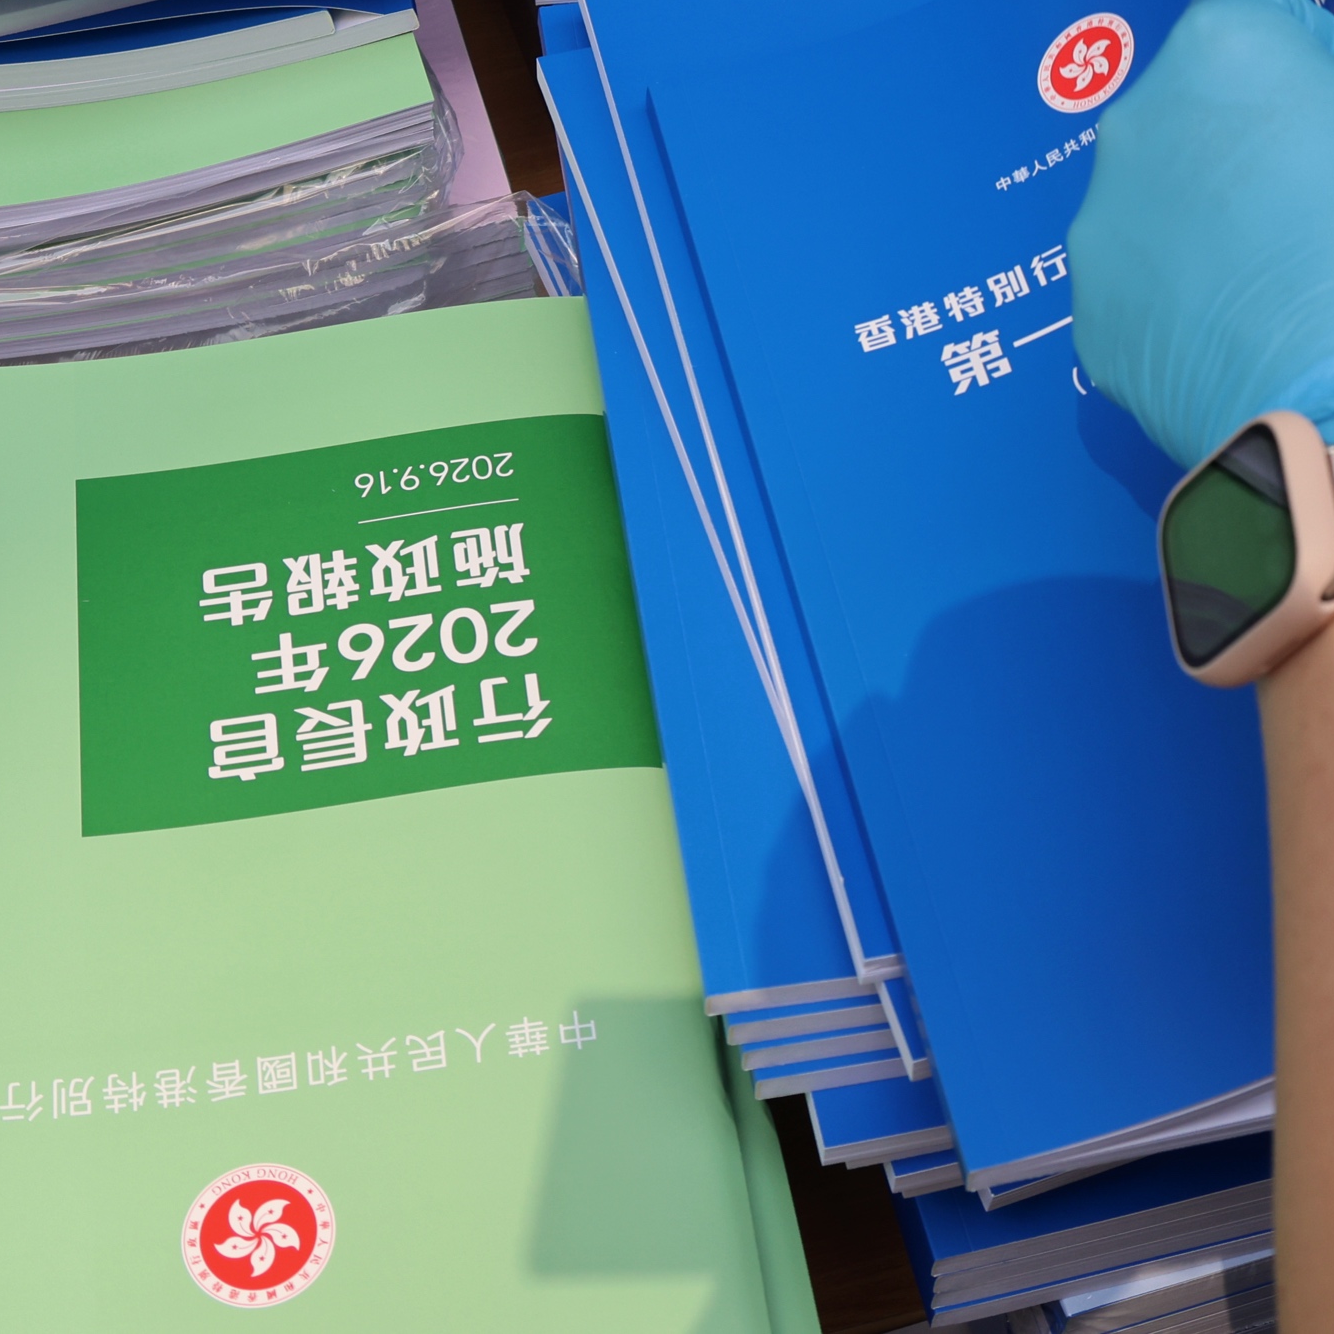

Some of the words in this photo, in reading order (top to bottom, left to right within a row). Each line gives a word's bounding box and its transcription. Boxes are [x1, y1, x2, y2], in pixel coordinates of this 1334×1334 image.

[995, 123, 1099, 192] 中華人民共和
[854, 245, 1067, 352] 香港特別行
[940, 316, 1073, 396] 第一
[354, 451, 514, 498] 2026.9.16
[197, 522, 530, 627] 施政報告
[251, 599, 539, 696] 2026年
[207, 672, 552, 783] 行政長官
[211, 1169, 251, 1197] KONG
[257, 1167, 299, 1187] HONG
